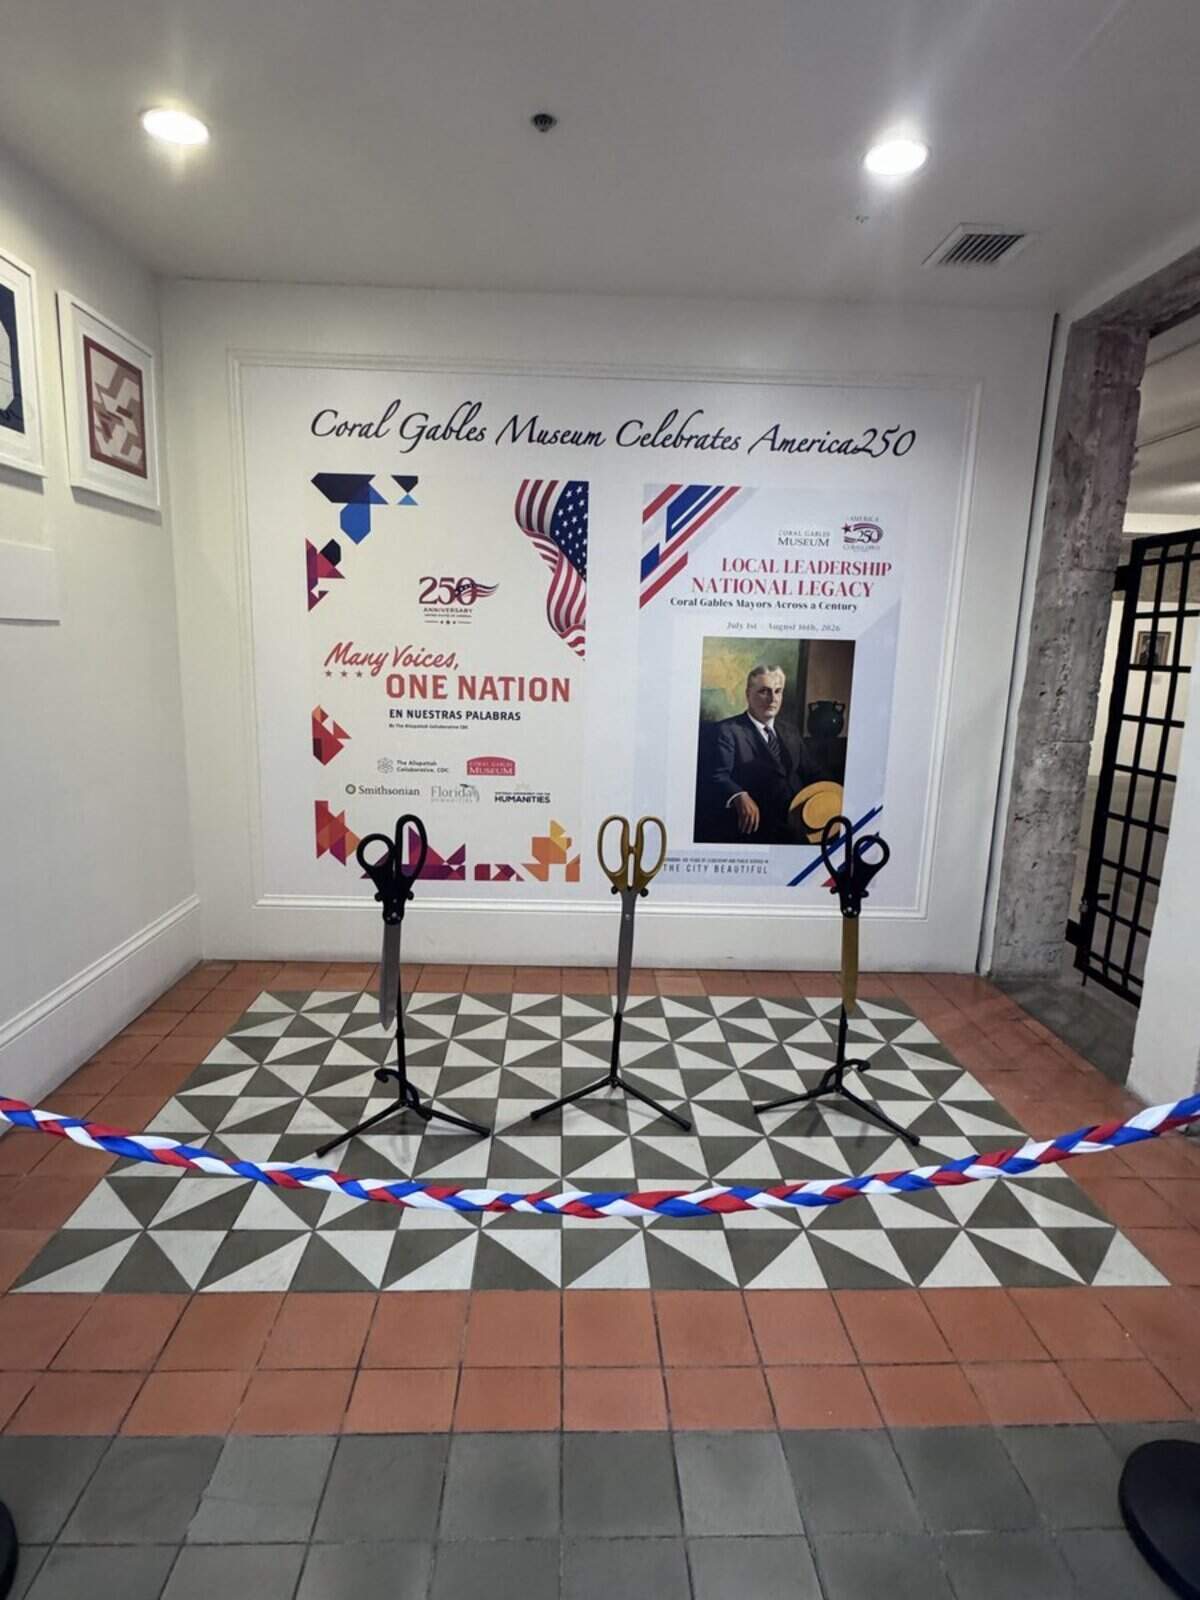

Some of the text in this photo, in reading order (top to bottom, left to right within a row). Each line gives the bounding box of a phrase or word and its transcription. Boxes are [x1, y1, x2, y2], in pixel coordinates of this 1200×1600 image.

[310, 398, 402, 439] Coral
[399, 400, 488, 454] Gables
[494, 414, 608, 448] Museum
[615, 408, 743, 451] Celebrates
[777, 537, 830, 547] MUSEUM
[721, 557, 893, 577] LOCAL LEADERSHIP
[418, 576, 478, 606] 250
[692, 577, 875, 598] NATIONAL LEGACY
[670, 597, 698, 607] Coral
[699, 597, 734, 608] Gables
[736, 599, 773, 611] Mayors
[774, 599, 808, 610] Across
[818, 601, 858, 613] Century
[323, 640, 460, 677] Many Voices,
[385, 673, 571, 703] ONE NATION
[388, 708, 522, 722] EN NUESTRAS PALABRAS
[469, 766, 513, 775] MUSEUM
[358, 784, 421, 797] Smithsonian
[431, 784, 473, 799] Florida
[494, 795, 552, 804] HUMANITIES
[663, 863, 768, 874] THE CITY BEAUTIFUL
